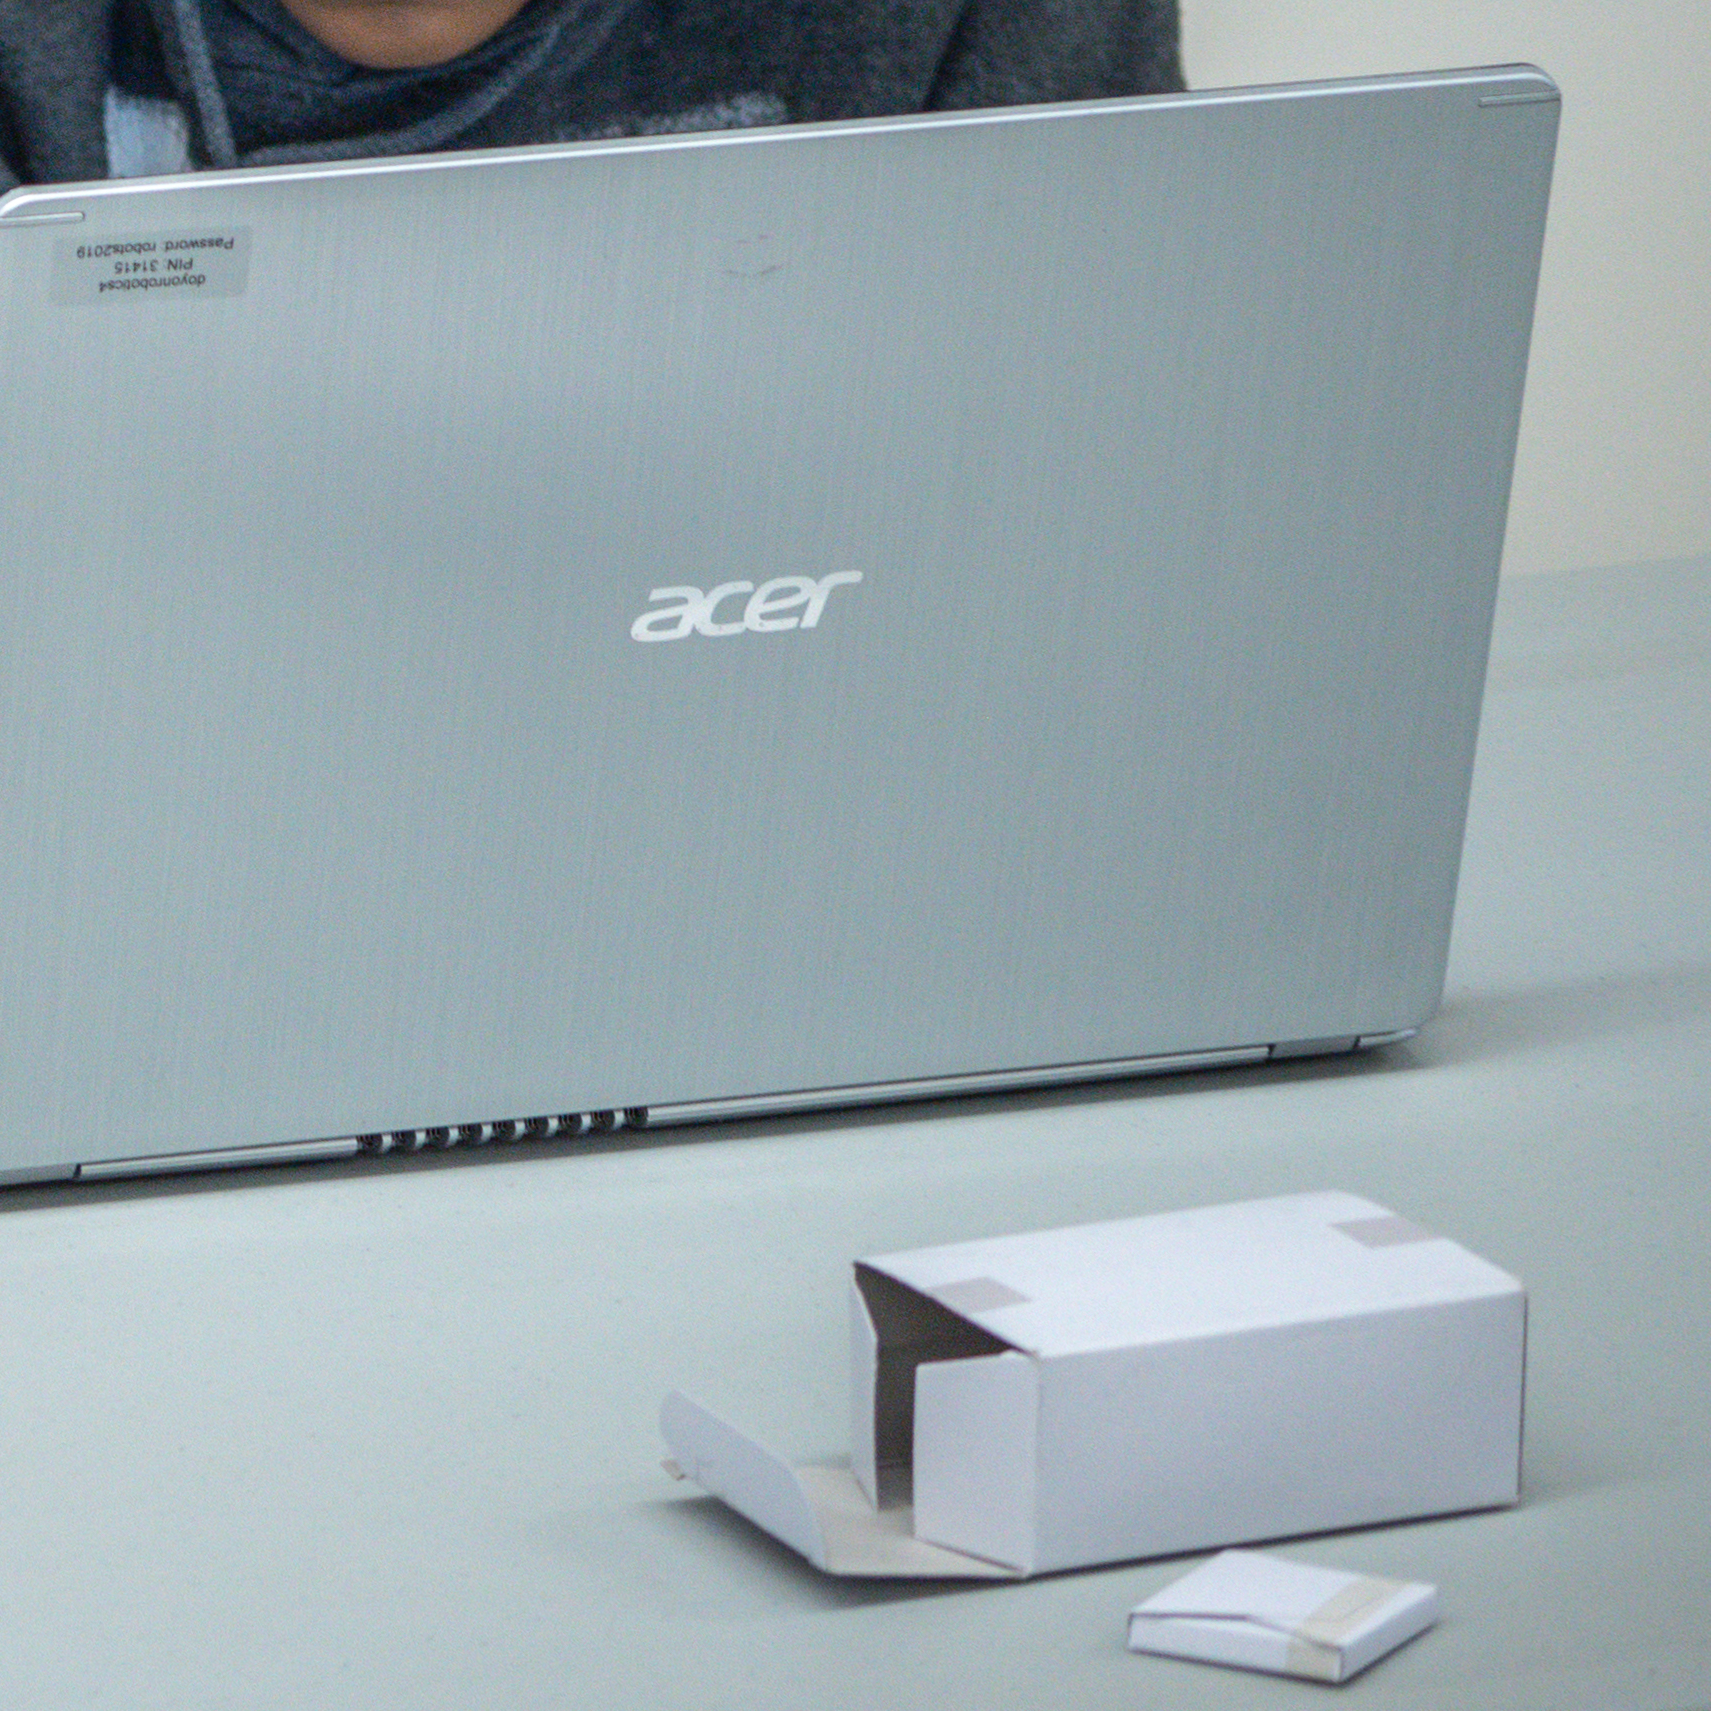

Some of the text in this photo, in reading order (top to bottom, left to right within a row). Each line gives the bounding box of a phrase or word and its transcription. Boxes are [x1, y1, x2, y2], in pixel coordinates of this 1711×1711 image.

[76, 241, 157, 259] robots2019
[114, 259, 159, 275] 31415
[629, 569, 864, 643] acer
